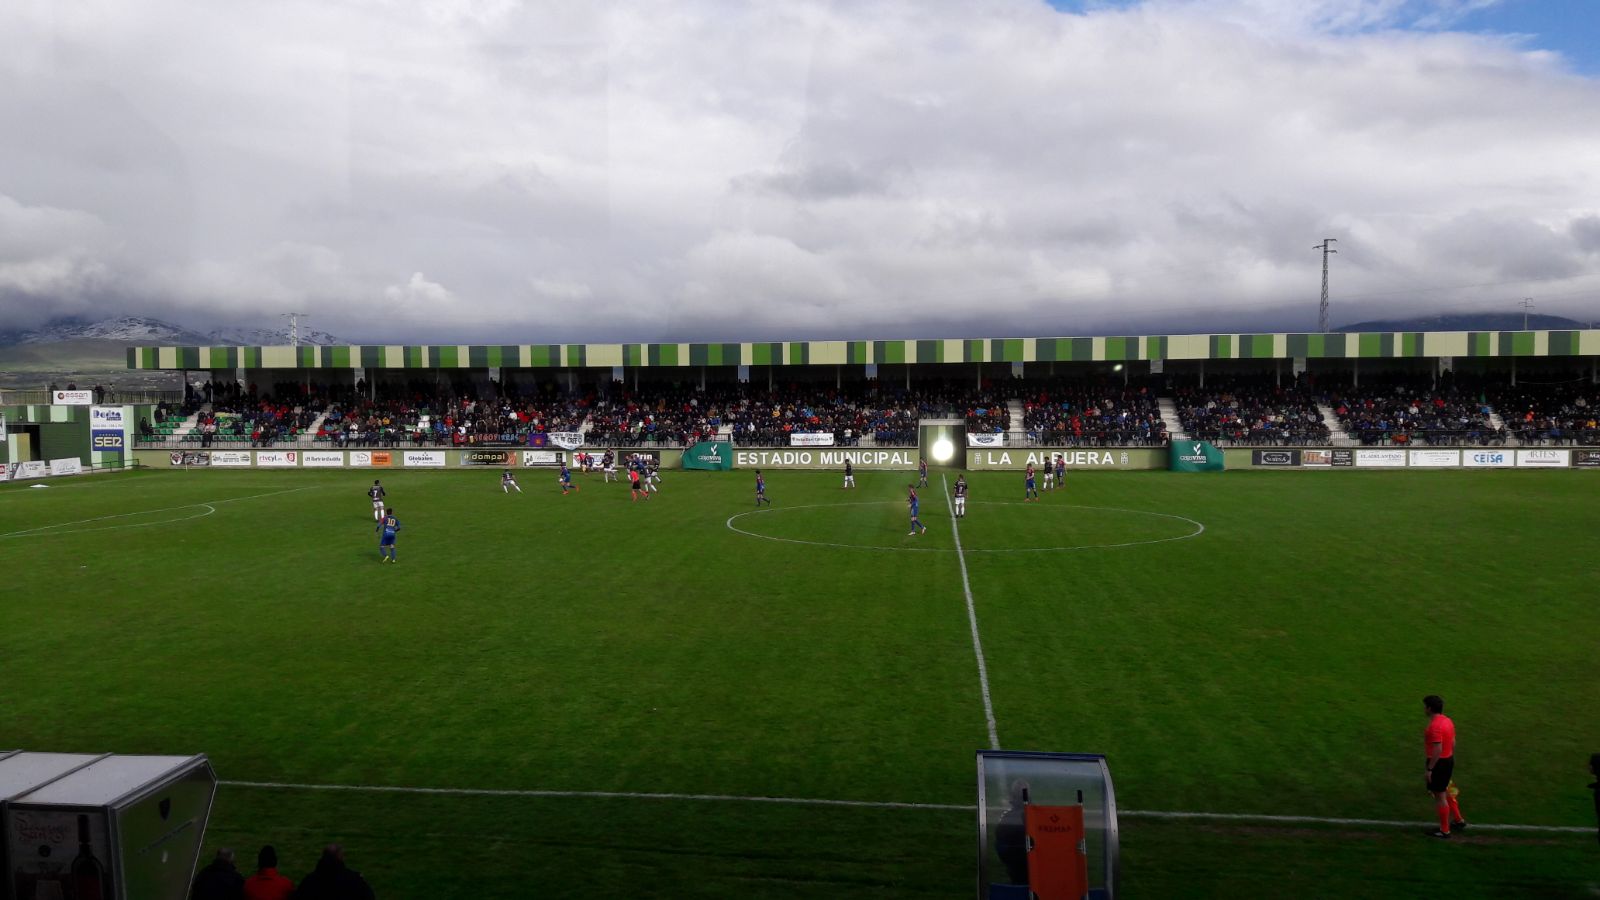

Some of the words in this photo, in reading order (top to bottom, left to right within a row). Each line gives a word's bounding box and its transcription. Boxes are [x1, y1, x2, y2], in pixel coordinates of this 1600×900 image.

[94, 436, 123, 447] SER
[471, 453, 505, 462] dompal
[737, 452, 812, 465] ESTADIO
[820, 451, 913, 465] MUNICIPAL
[987, 452, 1012, 465] LA
[1025, 452, 1115, 465] ALBUERA
[1473, 454, 1504, 463] CEISA
[386, 517, 396, 527] 10
